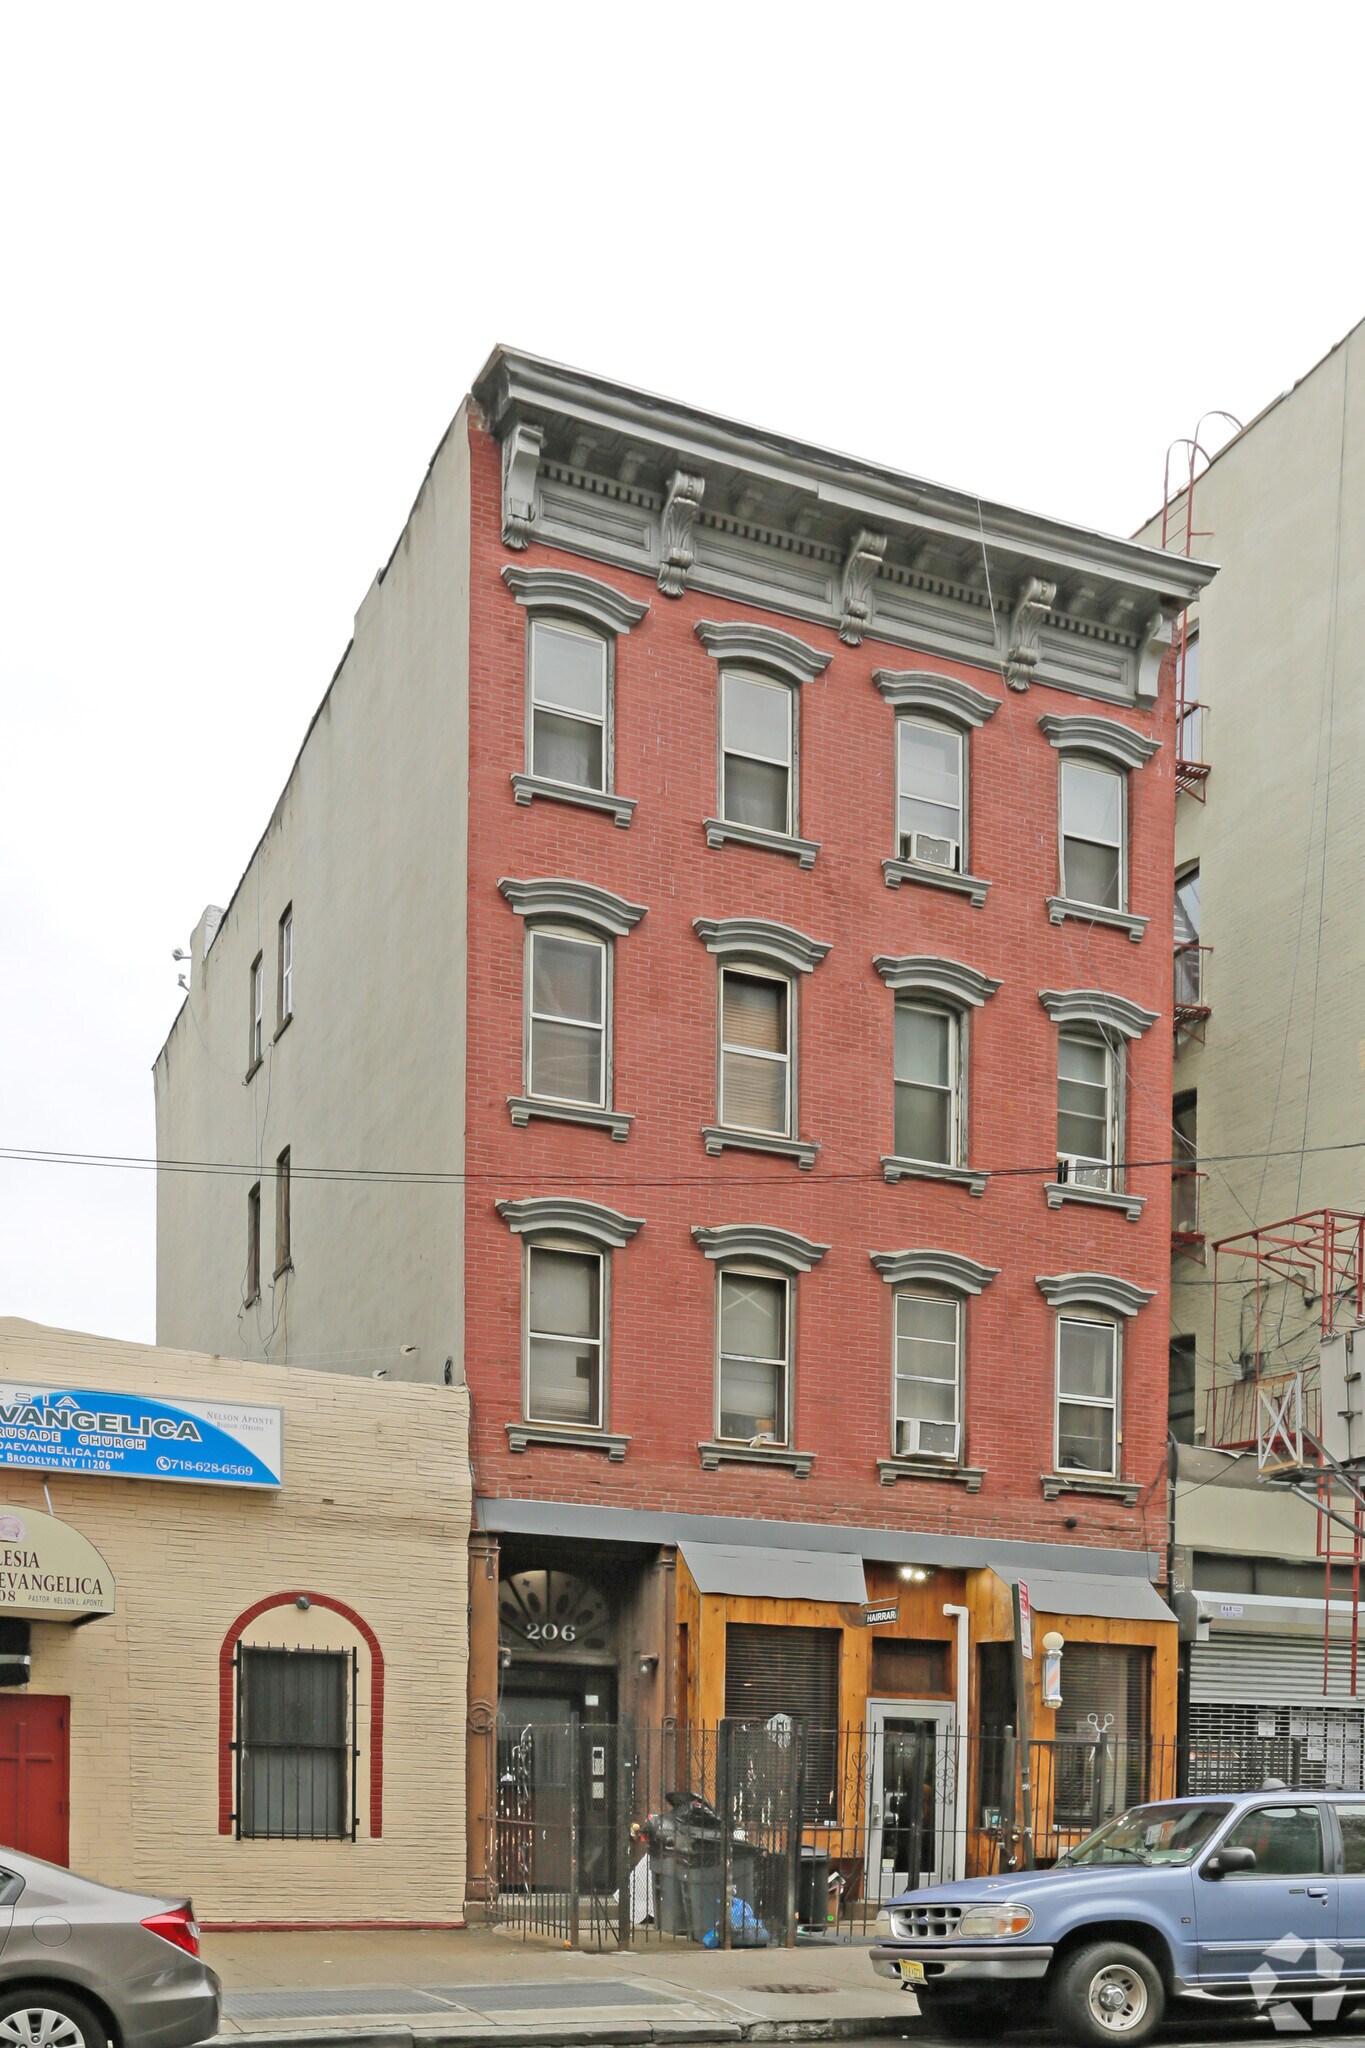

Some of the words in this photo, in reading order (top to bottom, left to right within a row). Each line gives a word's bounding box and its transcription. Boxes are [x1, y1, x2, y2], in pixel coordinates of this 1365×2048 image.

[206, 1411, 239, 1422] NELSON
[242, 1414, 275, 1425] APONTE
[78, 1434, 147, 1451] CHURCH
[7, 1452, 59, 1466] BROOKLYN
[62, 1457, 77, 1467] NY
[82, 1459, 111, 1470] 11206
[170, 1459, 253, 1475] 718-628-6569
[0, 1572, 103, 1595] EVANGELICA
[53, 1597, 76, 1605] NELSON
[83, 1599, 104, 1607] APONTE
[526, 1623, 576, 1642] 206
